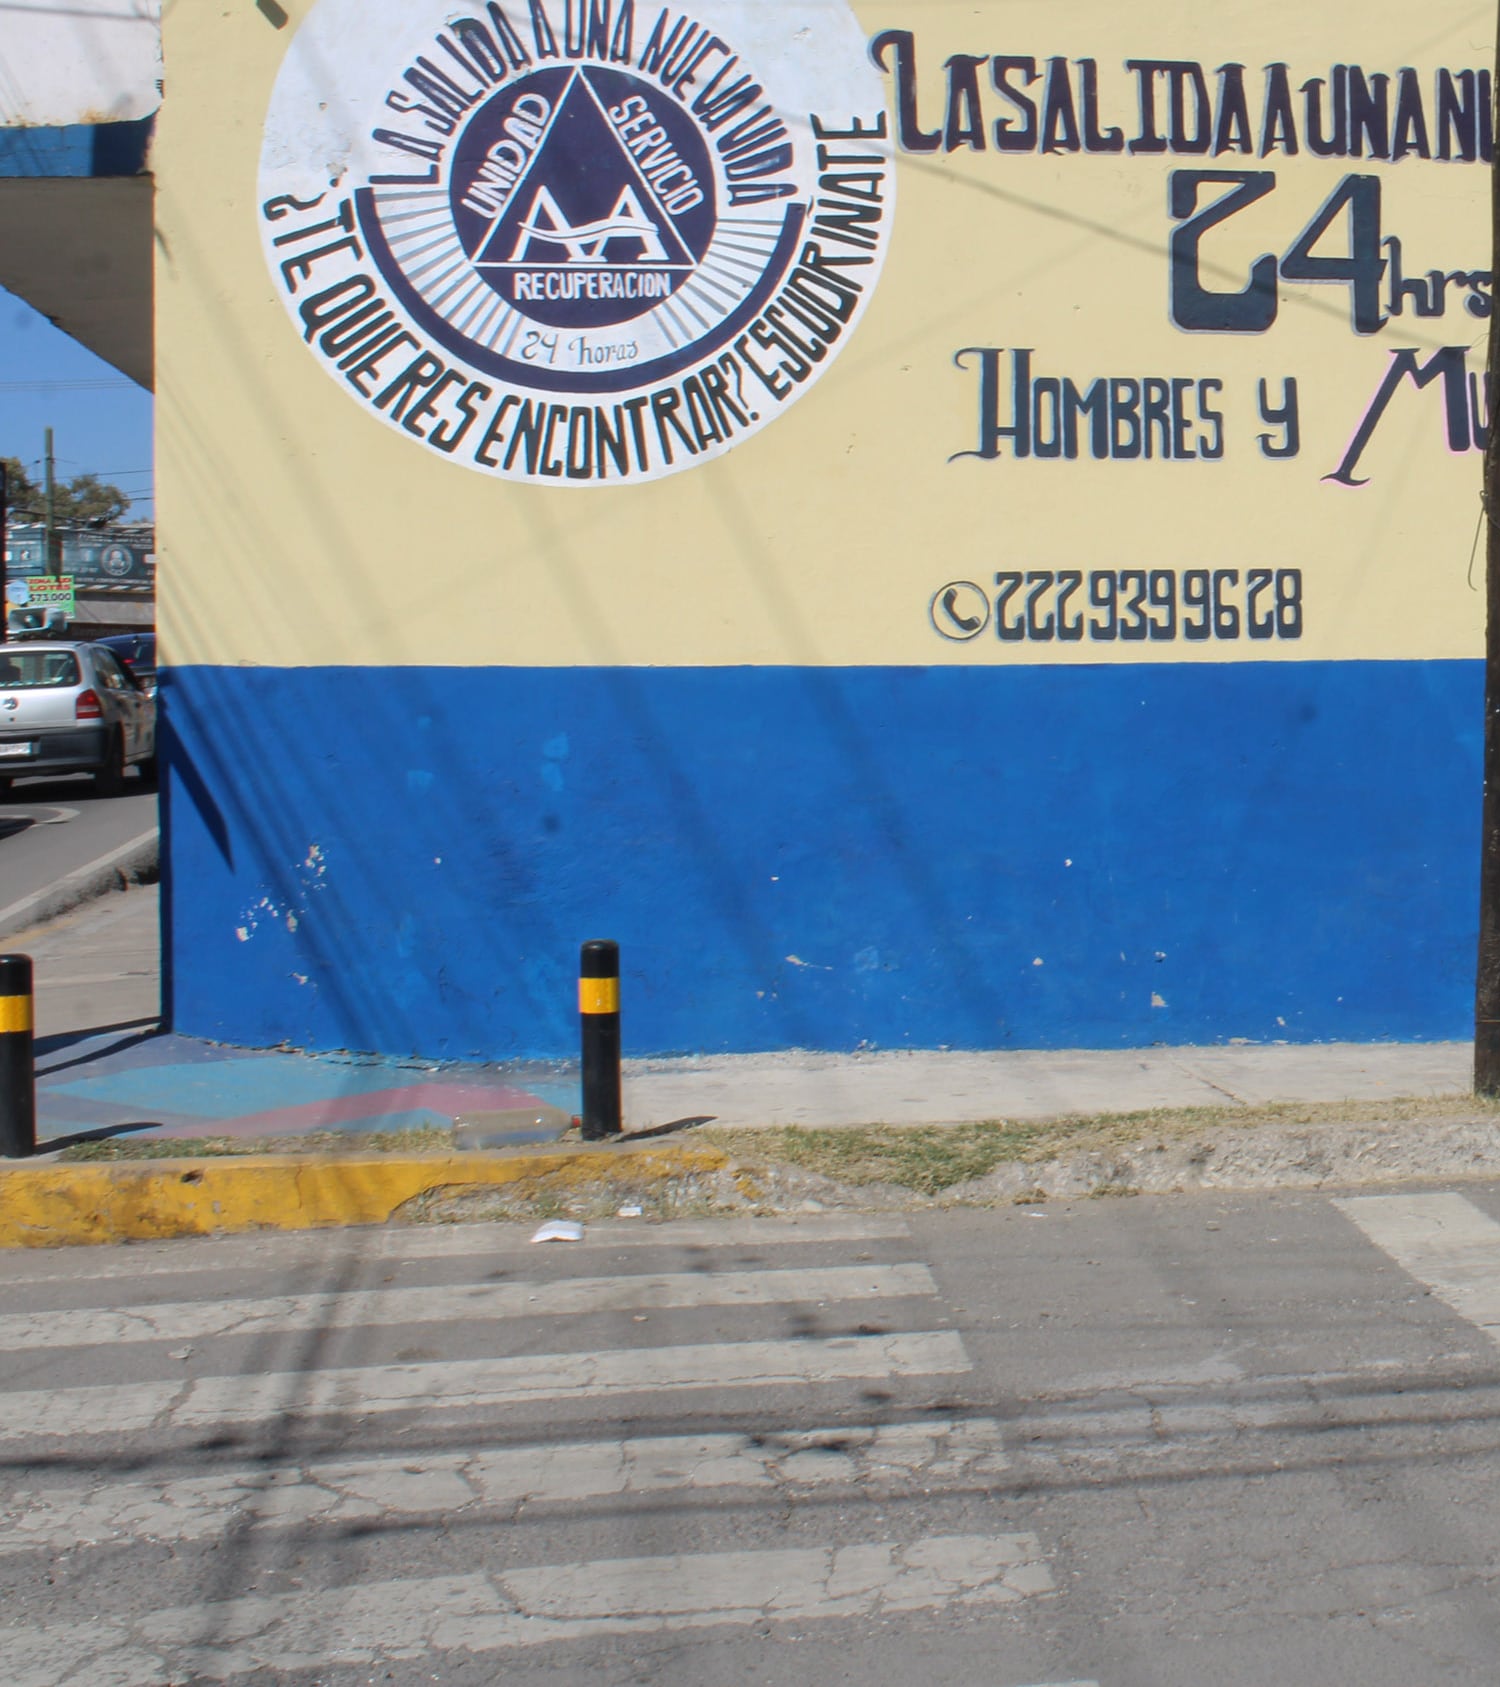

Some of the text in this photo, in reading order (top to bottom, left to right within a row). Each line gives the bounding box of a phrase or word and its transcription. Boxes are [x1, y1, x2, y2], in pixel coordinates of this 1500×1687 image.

[368, 0, 798, 207] LA SALIDA A UNA NUEVA VIDA
[461, 93, 551, 219] UNIDAD
[608, 95, 704, 216] SERVICIO
[514, 272, 671, 300] RECUPERACION
[298, 273, 492, 453] QUIERES
[474, 351, 760, 479] ENCONTRAR?
[521, 330, 639, 366] 24 horas
[948, 346, 1226, 463] HOMBRES
